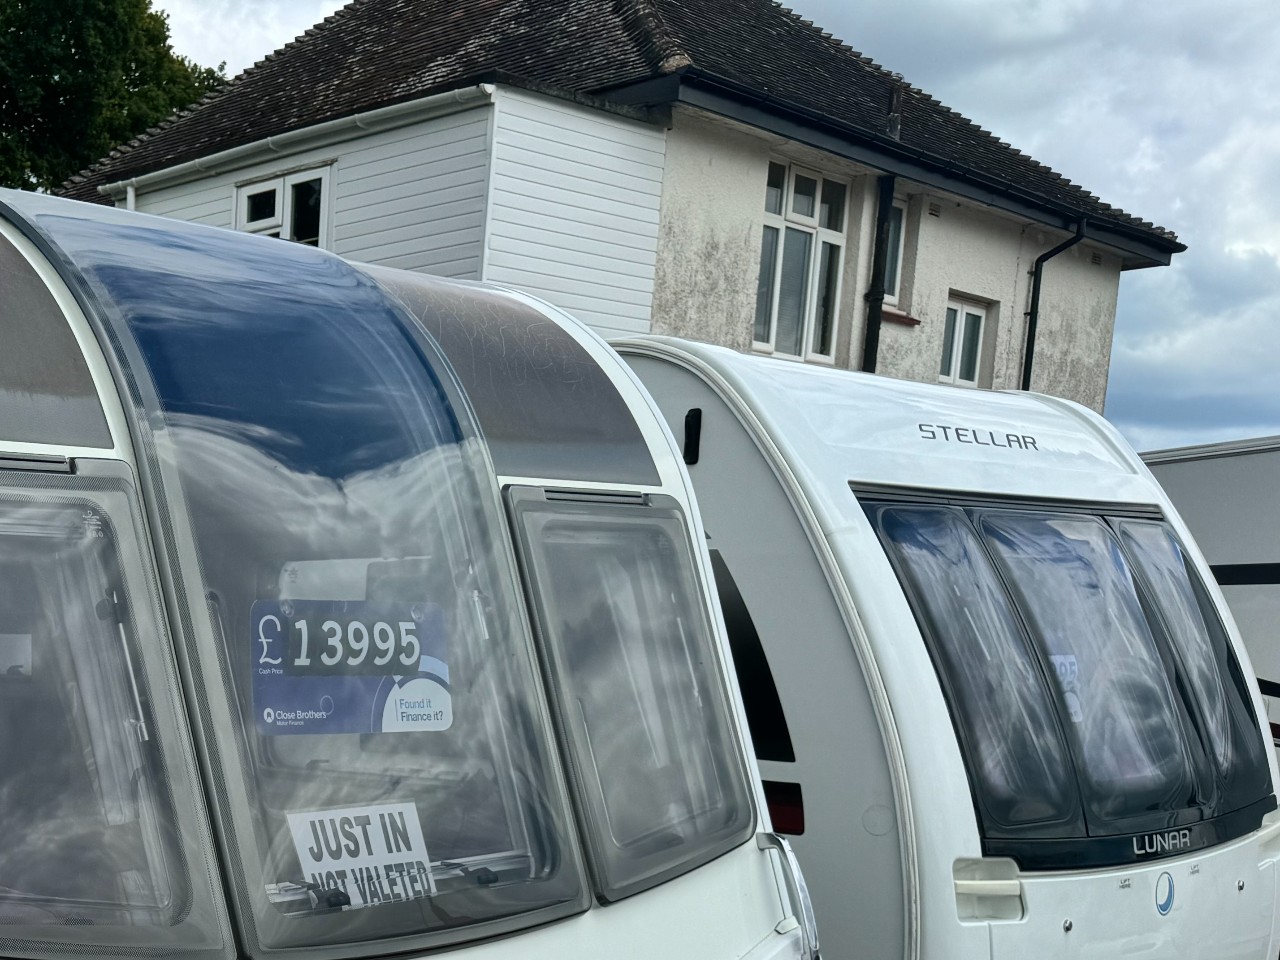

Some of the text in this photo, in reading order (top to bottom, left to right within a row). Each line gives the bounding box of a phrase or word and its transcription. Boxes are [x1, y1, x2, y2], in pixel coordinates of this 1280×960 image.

[918, 423, 1039, 451] STELLAR
[258, 614, 420, 666] £13995
[258, 667, 283, 675] Cash Price
[275, 710, 327, 720] Close Brothers
[399, 698, 432, 709] Found it
[400, 710, 443, 722] Finance it?
[308, 811, 413, 863] JUST IN
[1132, 829, 1190, 855] LUNAR
[350, 860, 432, 905] VALETED
